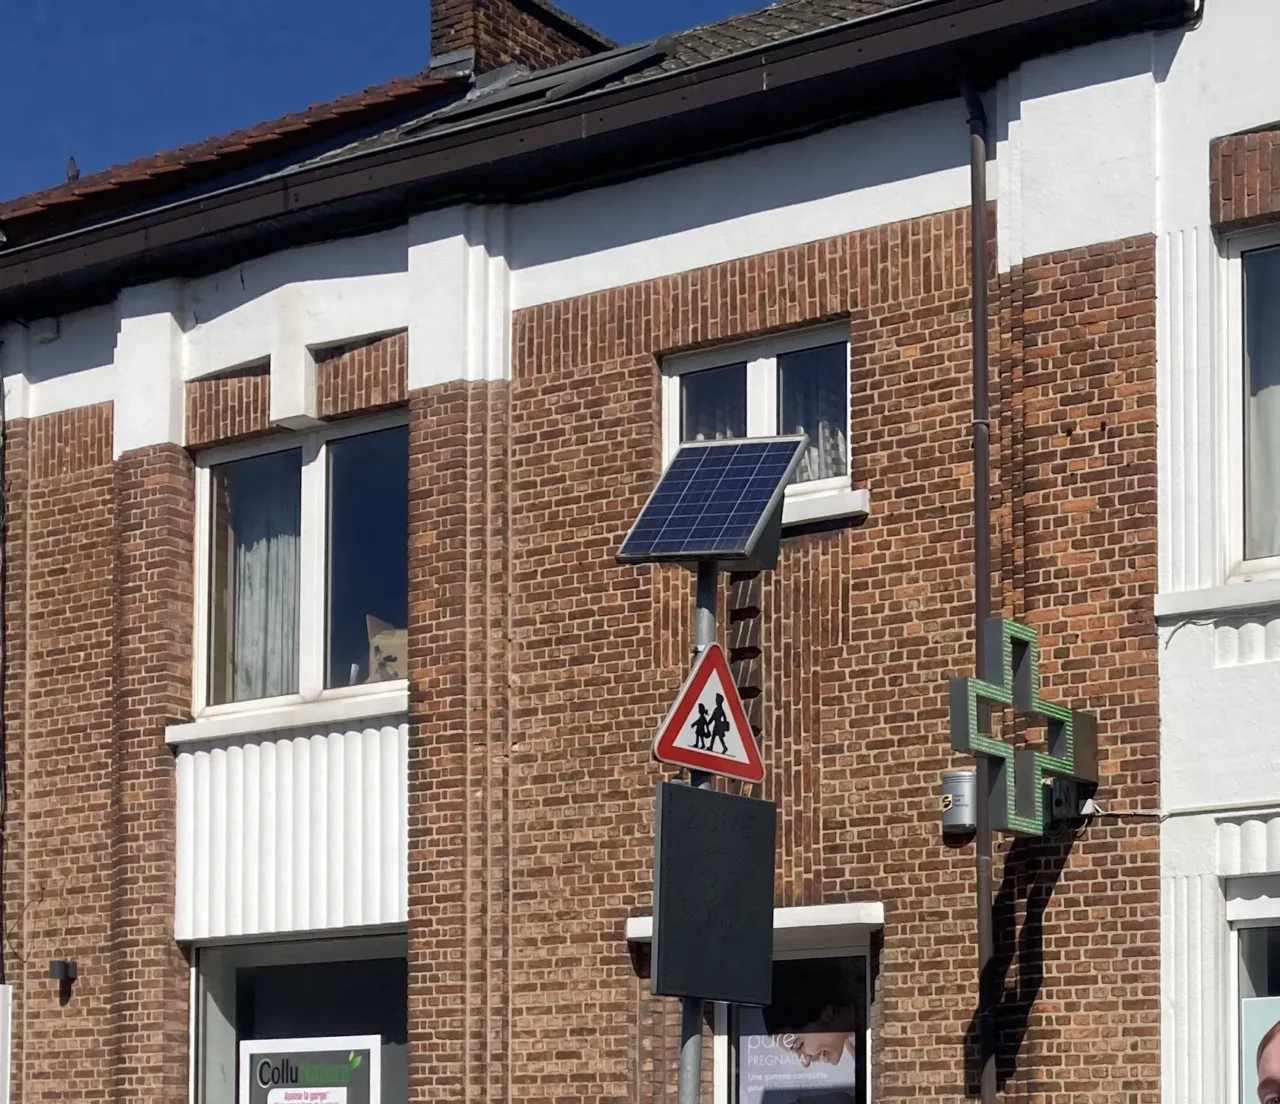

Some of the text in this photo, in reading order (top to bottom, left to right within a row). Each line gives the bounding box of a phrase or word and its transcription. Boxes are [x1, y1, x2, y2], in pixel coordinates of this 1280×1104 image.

[748, 1033, 795, 1054] pure
[748, 1073, 762, 1081] Une
[764, 1074, 791, 1083] gamme
[748, 1085, 764, 1093] pour
